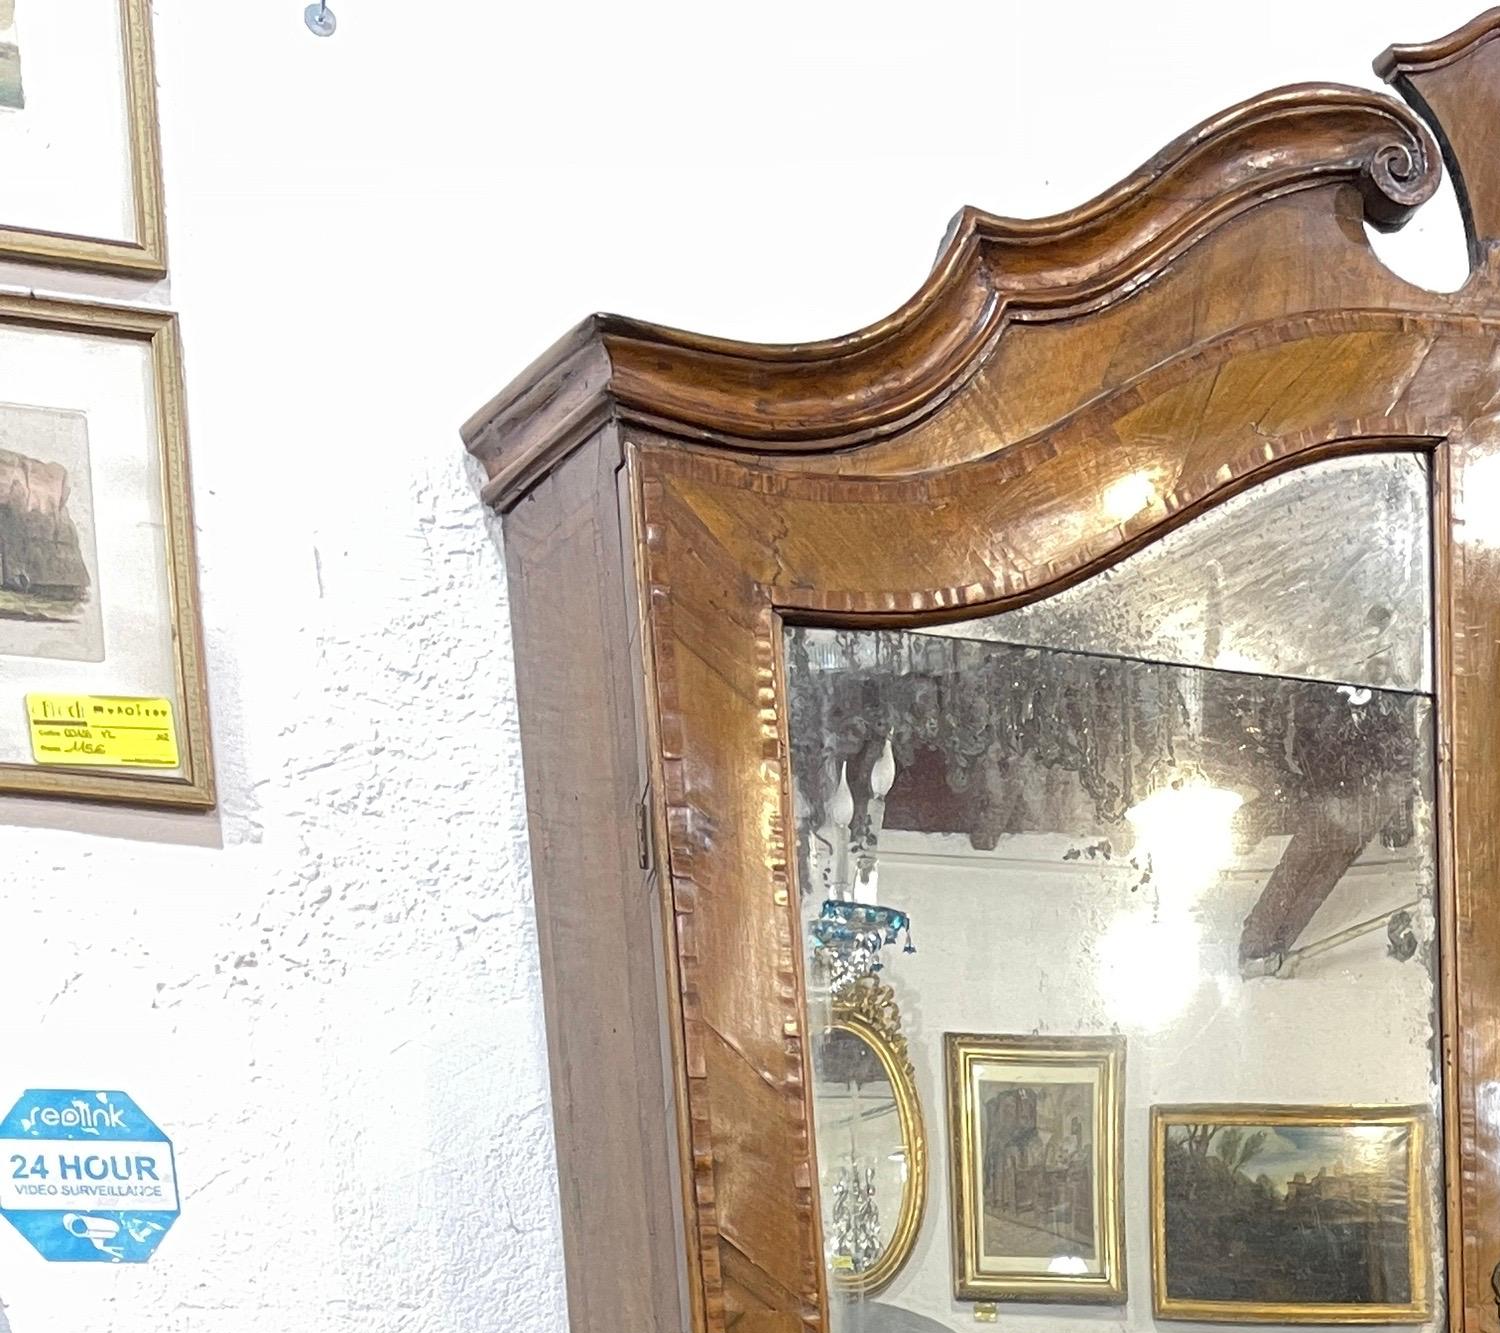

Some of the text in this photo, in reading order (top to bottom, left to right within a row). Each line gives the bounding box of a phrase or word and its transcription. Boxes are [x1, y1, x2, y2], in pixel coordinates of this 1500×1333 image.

[10, 1154, 159, 1181] 24 HOUR
[15, 1184, 163, 1198] VIDEO SURVEILLANCE
